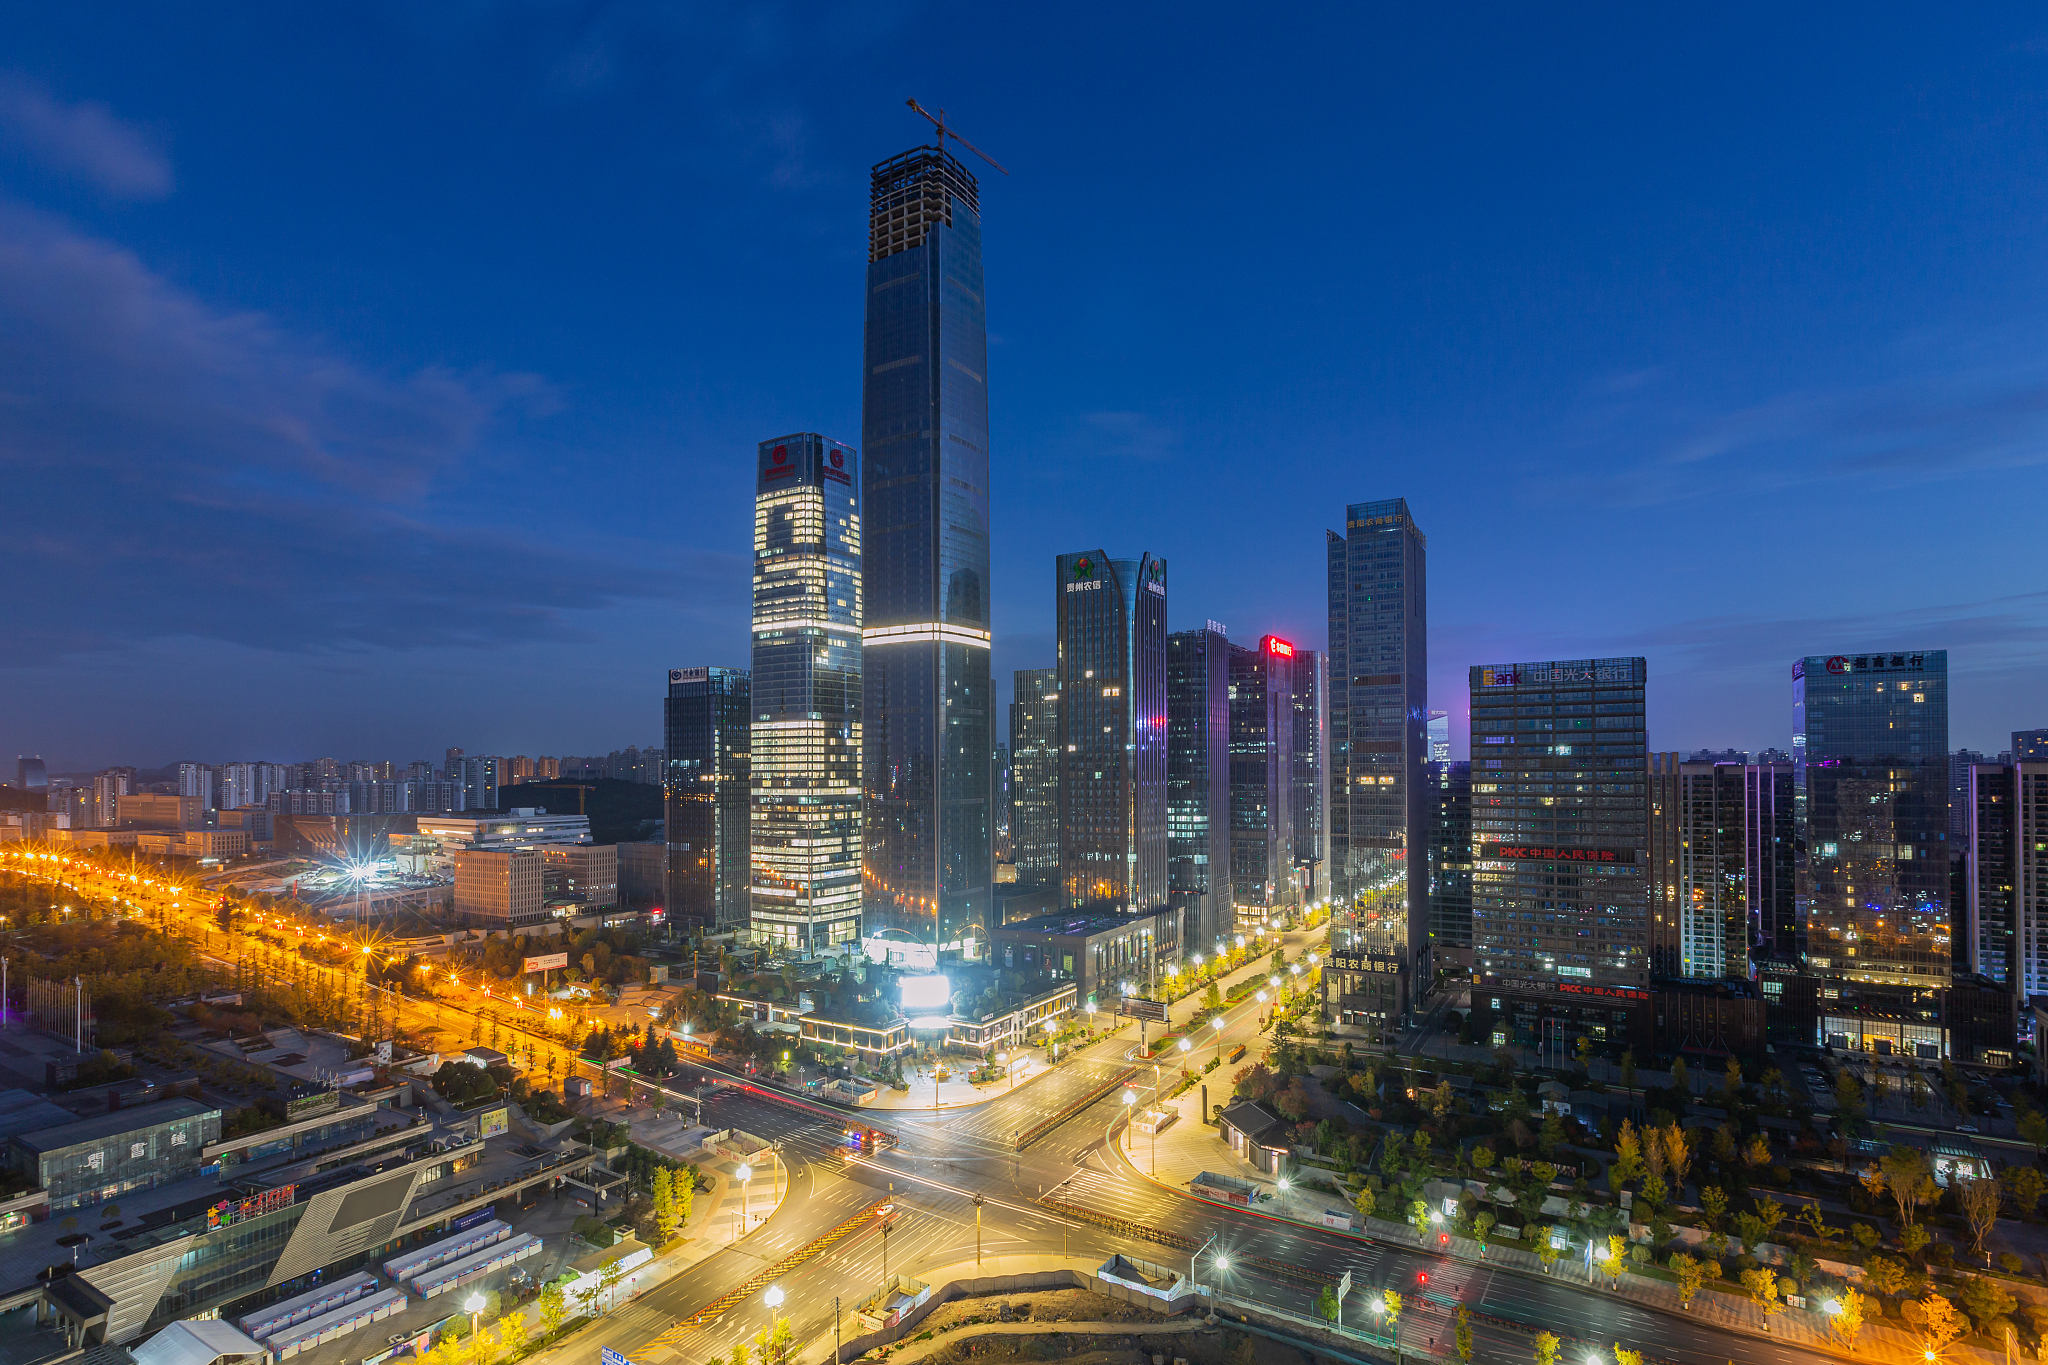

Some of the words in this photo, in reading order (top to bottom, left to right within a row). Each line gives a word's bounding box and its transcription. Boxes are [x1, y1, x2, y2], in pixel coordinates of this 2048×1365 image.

[1347, 514, 1403, 529] 贵阳农商银行
[1066, 580, 1101, 593] 贵州农信
[1853, 655, 1924, 669] 招商银行
[1533, 665, 1629, 683] 中国光大银行
[1499, 847, 1527, 858] PICC
[1529, 848, 1615, 861] 中国人民保险
[1323, 957, 1399, 974] 贵阳农商银行
[1502, 978, 1556, 991] 中国光大银行
[1559, 983, 1582, 994] PICC
[1583, 986, 1649, 1000] 中国人民保险
